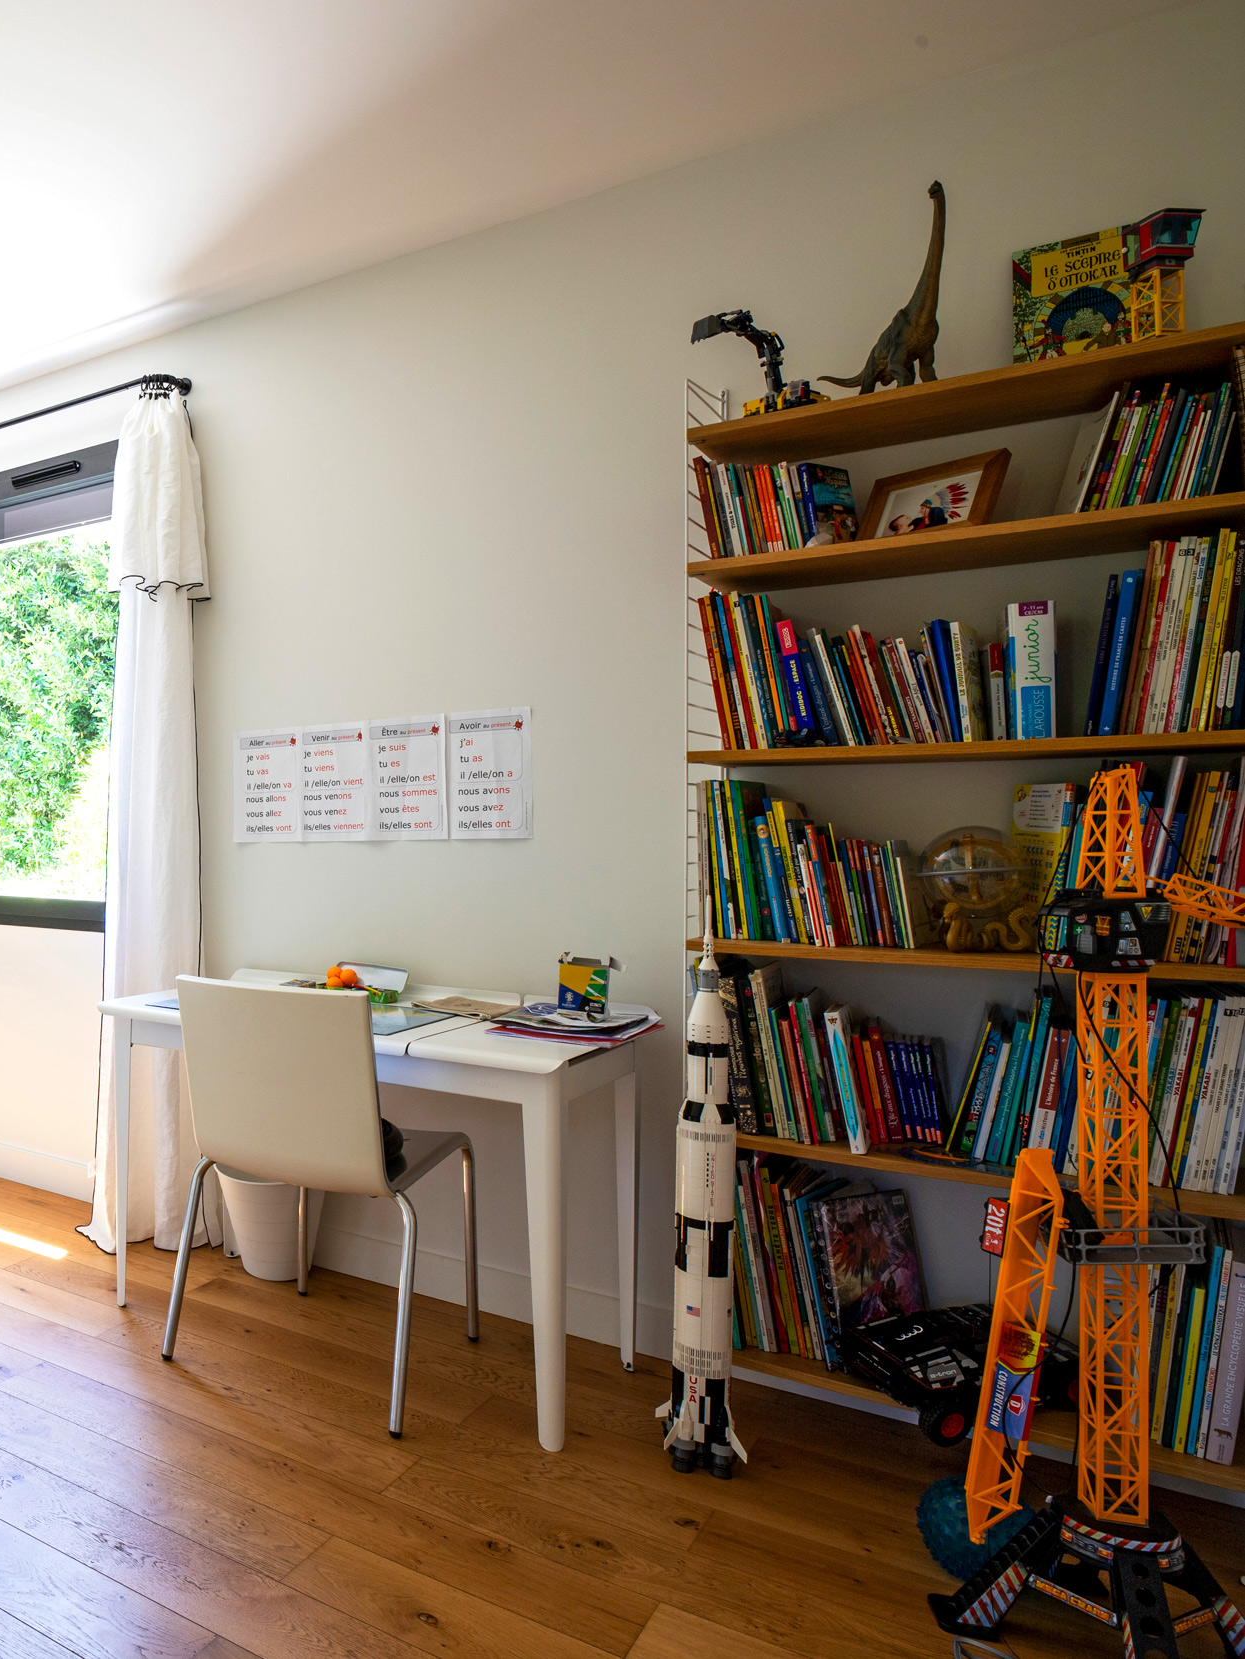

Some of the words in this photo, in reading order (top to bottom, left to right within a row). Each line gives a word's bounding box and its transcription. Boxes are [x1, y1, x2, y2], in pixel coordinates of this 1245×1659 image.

[1066, 246, 1096, 258] TINTIN
[1044, 265, 1058, 278] LE
[1065, 250, 1121, 272] SCEPTRE
[1235, 548, 1245, 574] DRAGONS
[1233, 574, 1242, 586] LES
[1023, 619, 1052, 683] junior
[1110, 668, 1118, 690] HISTOIRE
[1114, 642, 1122, 661] FRANCE
[796, 690, 807, 716] KIDIDOC
[1034, 689, 1045, 738] LAROUSSE
[382, 728, 398, 736] Être
[460, 722, 481, 730] Avoir
[312, 734, 329, 742] Venir
[460, 738, 473, 748] j'ai
[378, 744, 386, 753] je
[389, 743, 406, 751] suis
[246, 754, 253, 763] je
[304, 750, 311, 759] je
[380, 776, 384, 784] il
[380, 790, 399, 798] nous
[402, 788, 437, 797] sommes
[483, 787, 510, 795] avons
[246, 810, 263, 818] vous
[402, 804, 419, 812] êtes
[458, 804, 480, 812] vous
[246, 825, 273, 833] ils/elles
[304, 823, 331, 831] ils/elles
[380, 821, 411, 830] ils/elles
[458, 821, 492, 829] ils/elles
[1050, 1057, 1060, 1075] France
[1048, 1075, 1057, 1083] de
[1164, 1066, 1176, 1095] YAKARI
[1172, 1068, 1184, 1096] YAKARI
[1200, 1071, 1212, 1100] YAKARI
[1044, 1082, 1055, 1105] L'histoire
[1040, 1110, 1050, 1130] Histoire
[765, 1203, 778, 1230] TERRE
[769, 1232, 785, 1271] PLANÈTE
[1223, 1320, 1244, 1381] ENCYCLOPÉDIE
[688, 1376, 698, 1404] USA
[989, 1370, 1008, 1427] CONSTRUCTION
[1220, 1382, 1235, 1414] GRANDE
[1219, 1416, 1230, 1426] LA
[1035, 1580, 1068, 1601] MEGA
[1069, 1596, 1110, 1621] CRANE
